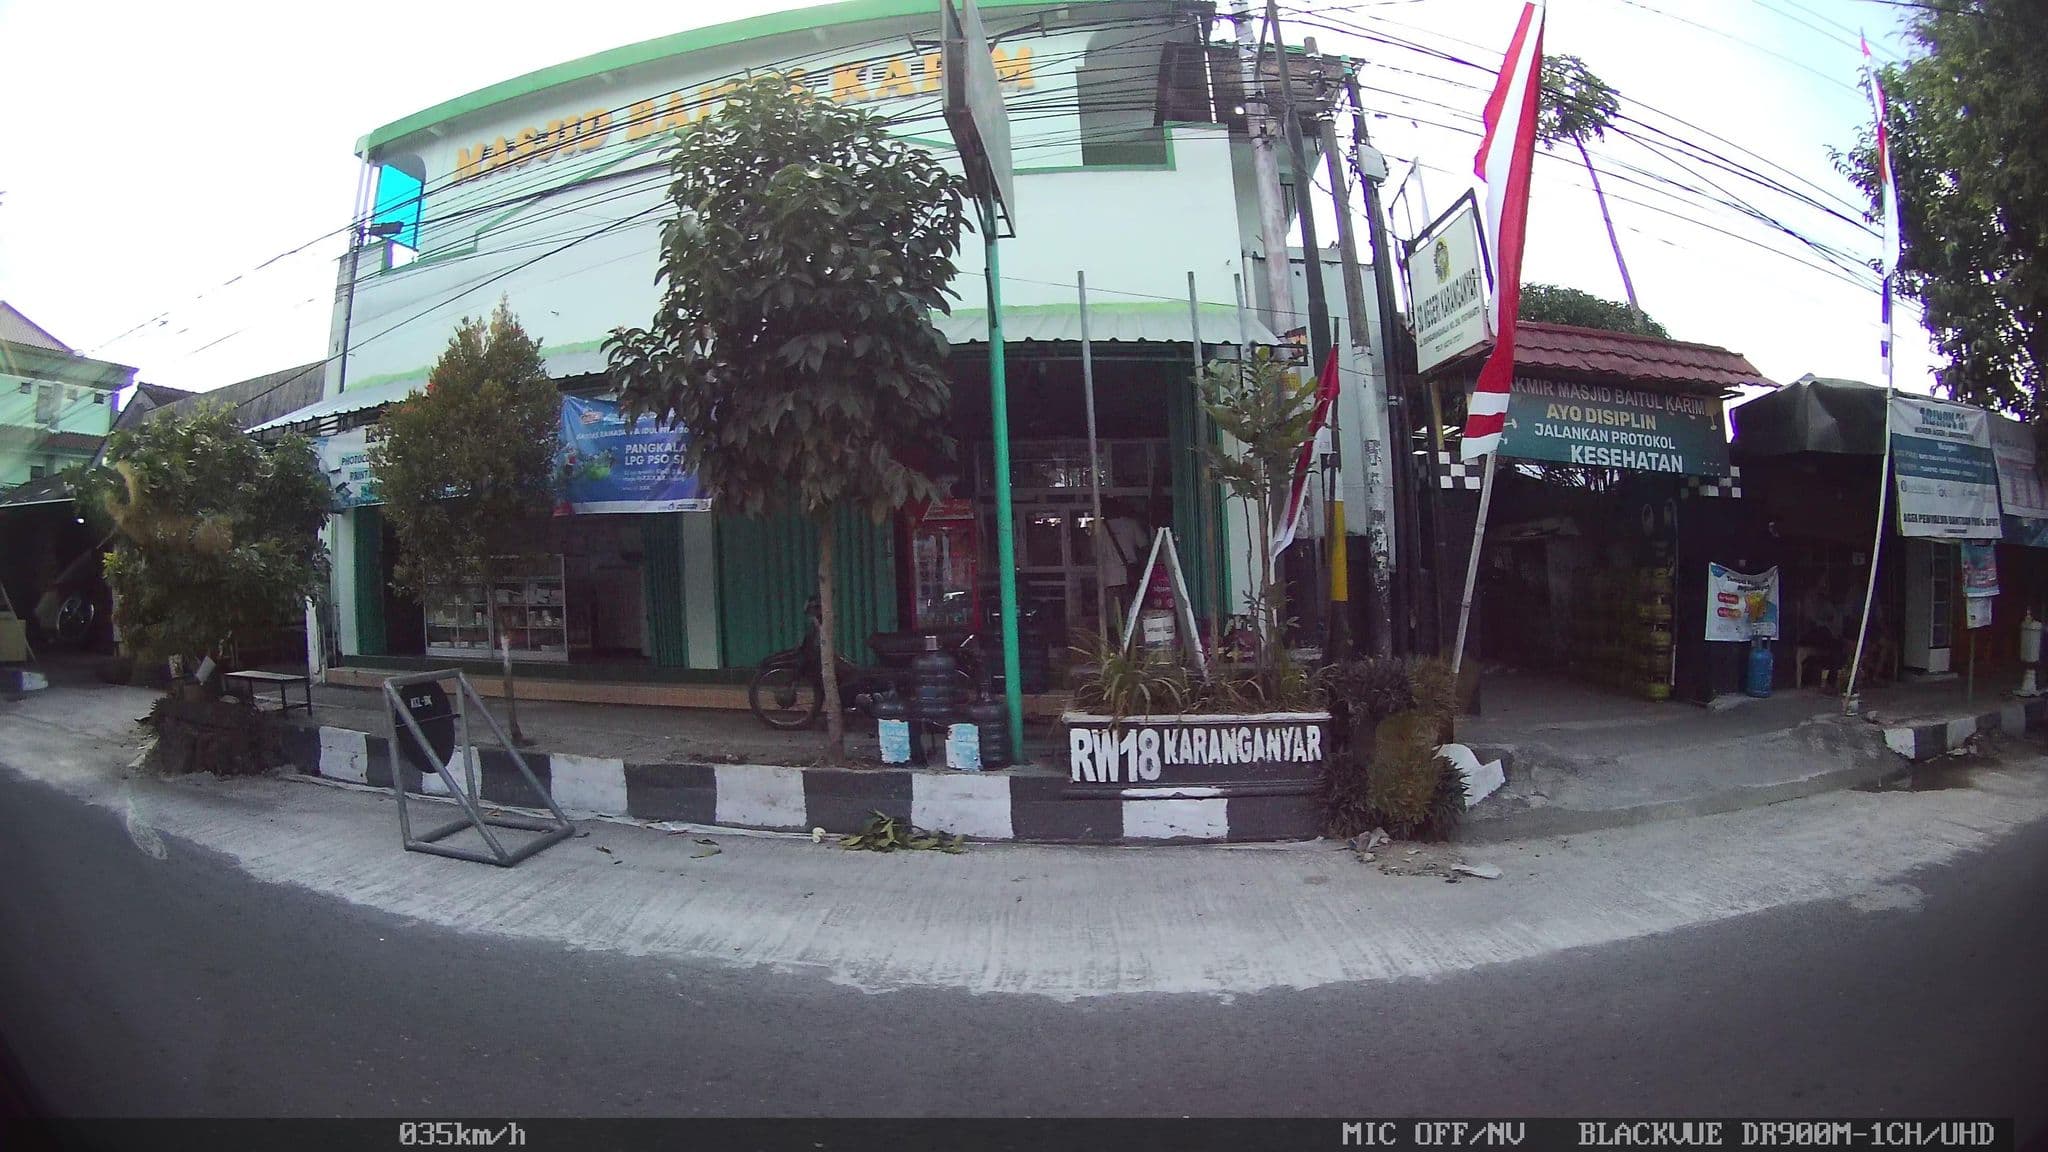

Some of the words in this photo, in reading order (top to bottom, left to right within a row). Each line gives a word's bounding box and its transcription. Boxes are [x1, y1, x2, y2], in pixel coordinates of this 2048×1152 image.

[454, 107, 612, 181] MASJID
[1510, 377, 1554, 397] AKMIR
[1558, 381, 1611, 403] MASJID
[1615, 388, 1663, 410] BAITUL
[1665, 394, 1705, 415] KARIM
[1546, 402, 1582, 422] AYO
[1585, 405, 1657, 431] DISIPLIN
[625, 442, 688, 454] PANGKALA
[1534, 422, 1609, 443] JALANKAN
[1611, 430, 1676, 450] PROTOKOL
[624, 455, 645, 466] LPG
[648, 454, 669, 465] PSO
[1570, 444, 1684, 474] KESEHATAN
[1163, 725, 1323, 765] KARANGANYAR
